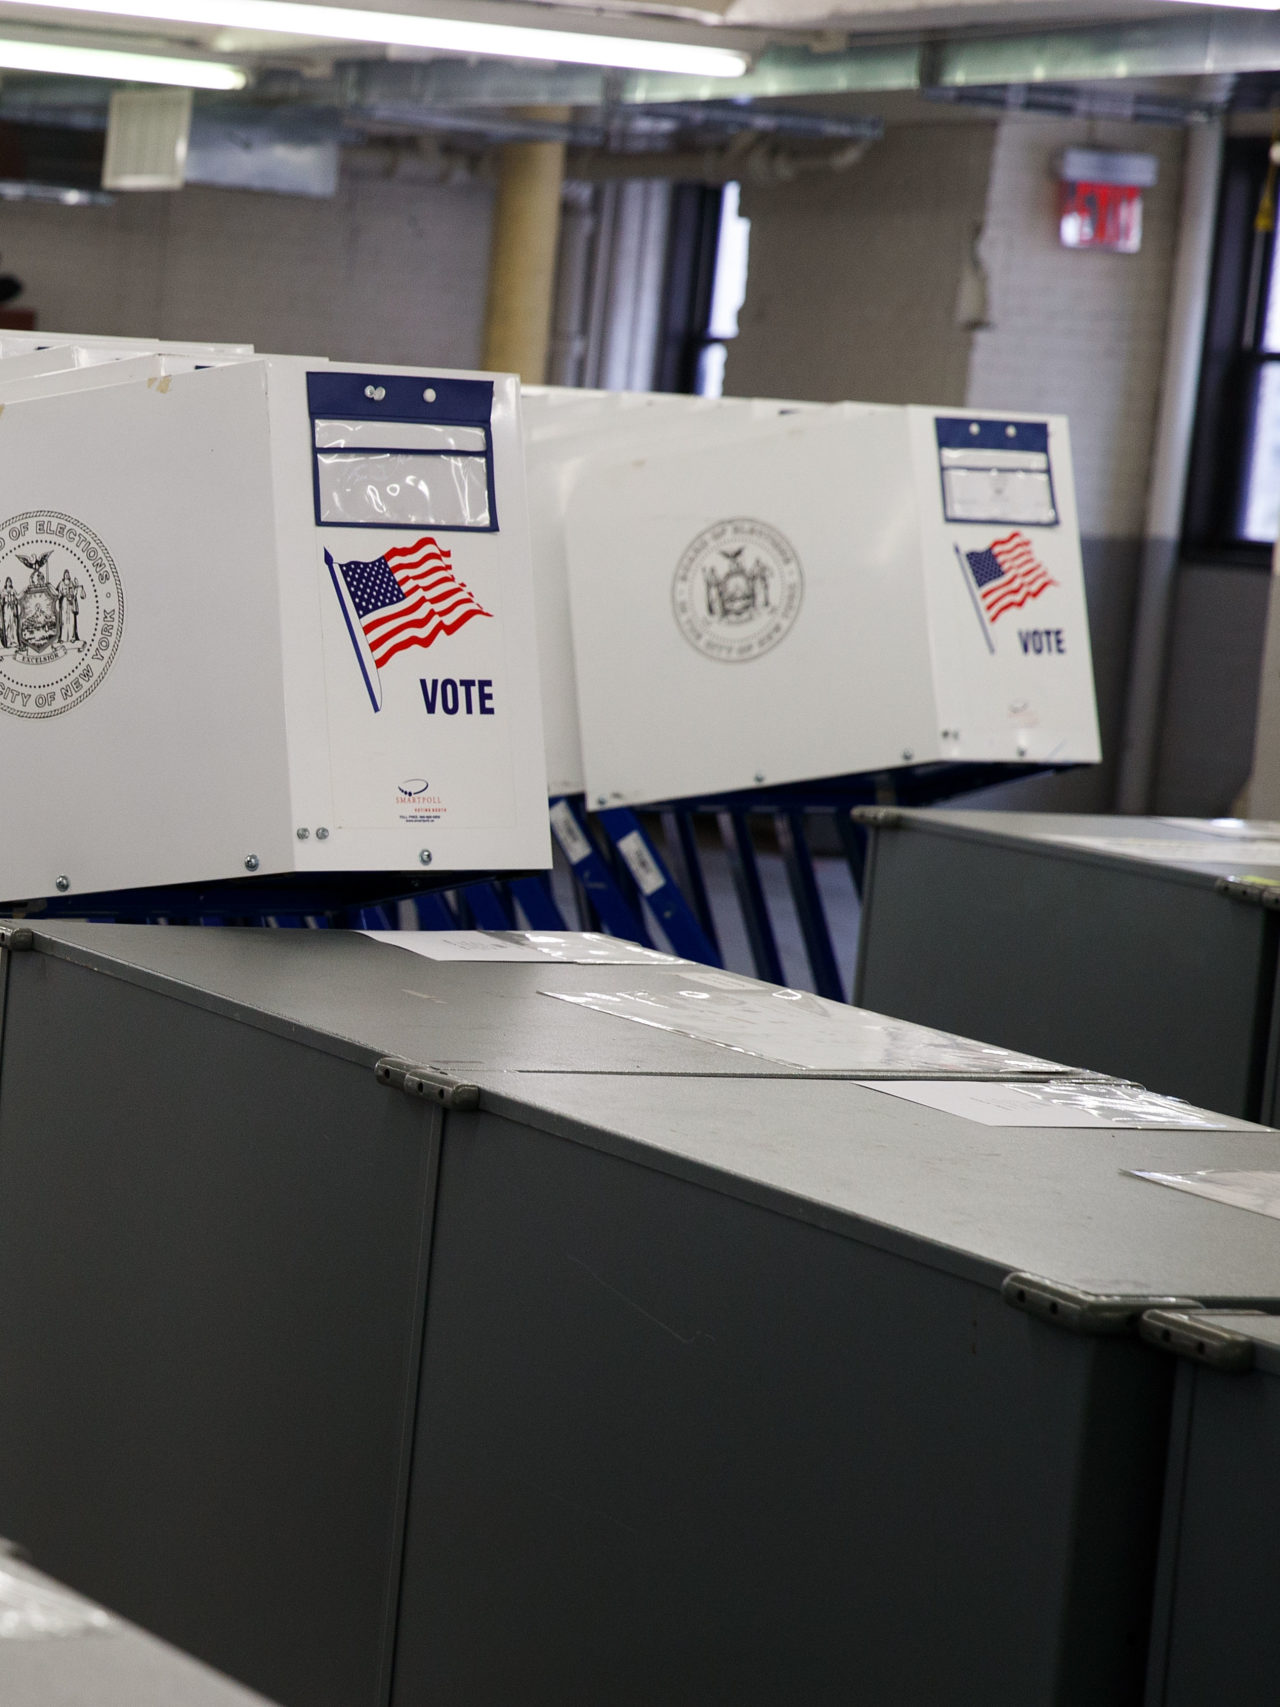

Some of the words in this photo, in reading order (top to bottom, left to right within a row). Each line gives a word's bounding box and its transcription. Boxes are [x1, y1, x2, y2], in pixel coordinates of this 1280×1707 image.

[9, 522, 29, 541] OF
[36, 520, 110, 585] ELECTIONS
[35, 692, 56, 708] OF
[60, 664, 95, 700] NEW
[92, 608, 116, 662] YORK
[1017, 628, 1066, 655] VOTE
[419, 678, 495, 715] VOTE
